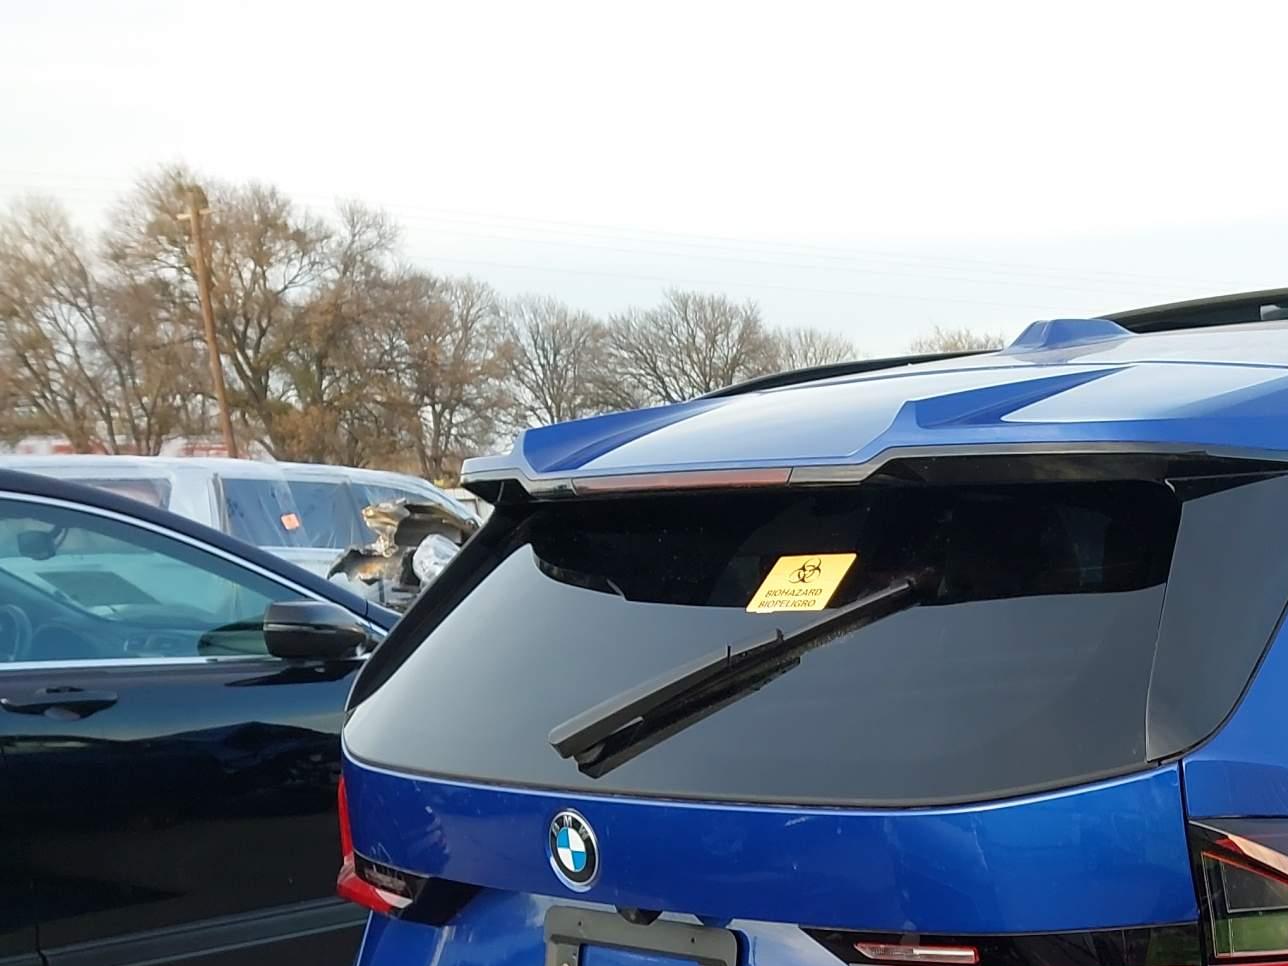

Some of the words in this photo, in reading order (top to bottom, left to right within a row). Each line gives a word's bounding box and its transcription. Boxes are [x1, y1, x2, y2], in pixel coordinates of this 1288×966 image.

[765, 588, 823, 598] BIOHAZARD
[758, 599, 816, 609] BIOPELIGRO
[551, 815, 590, 841] BMW
